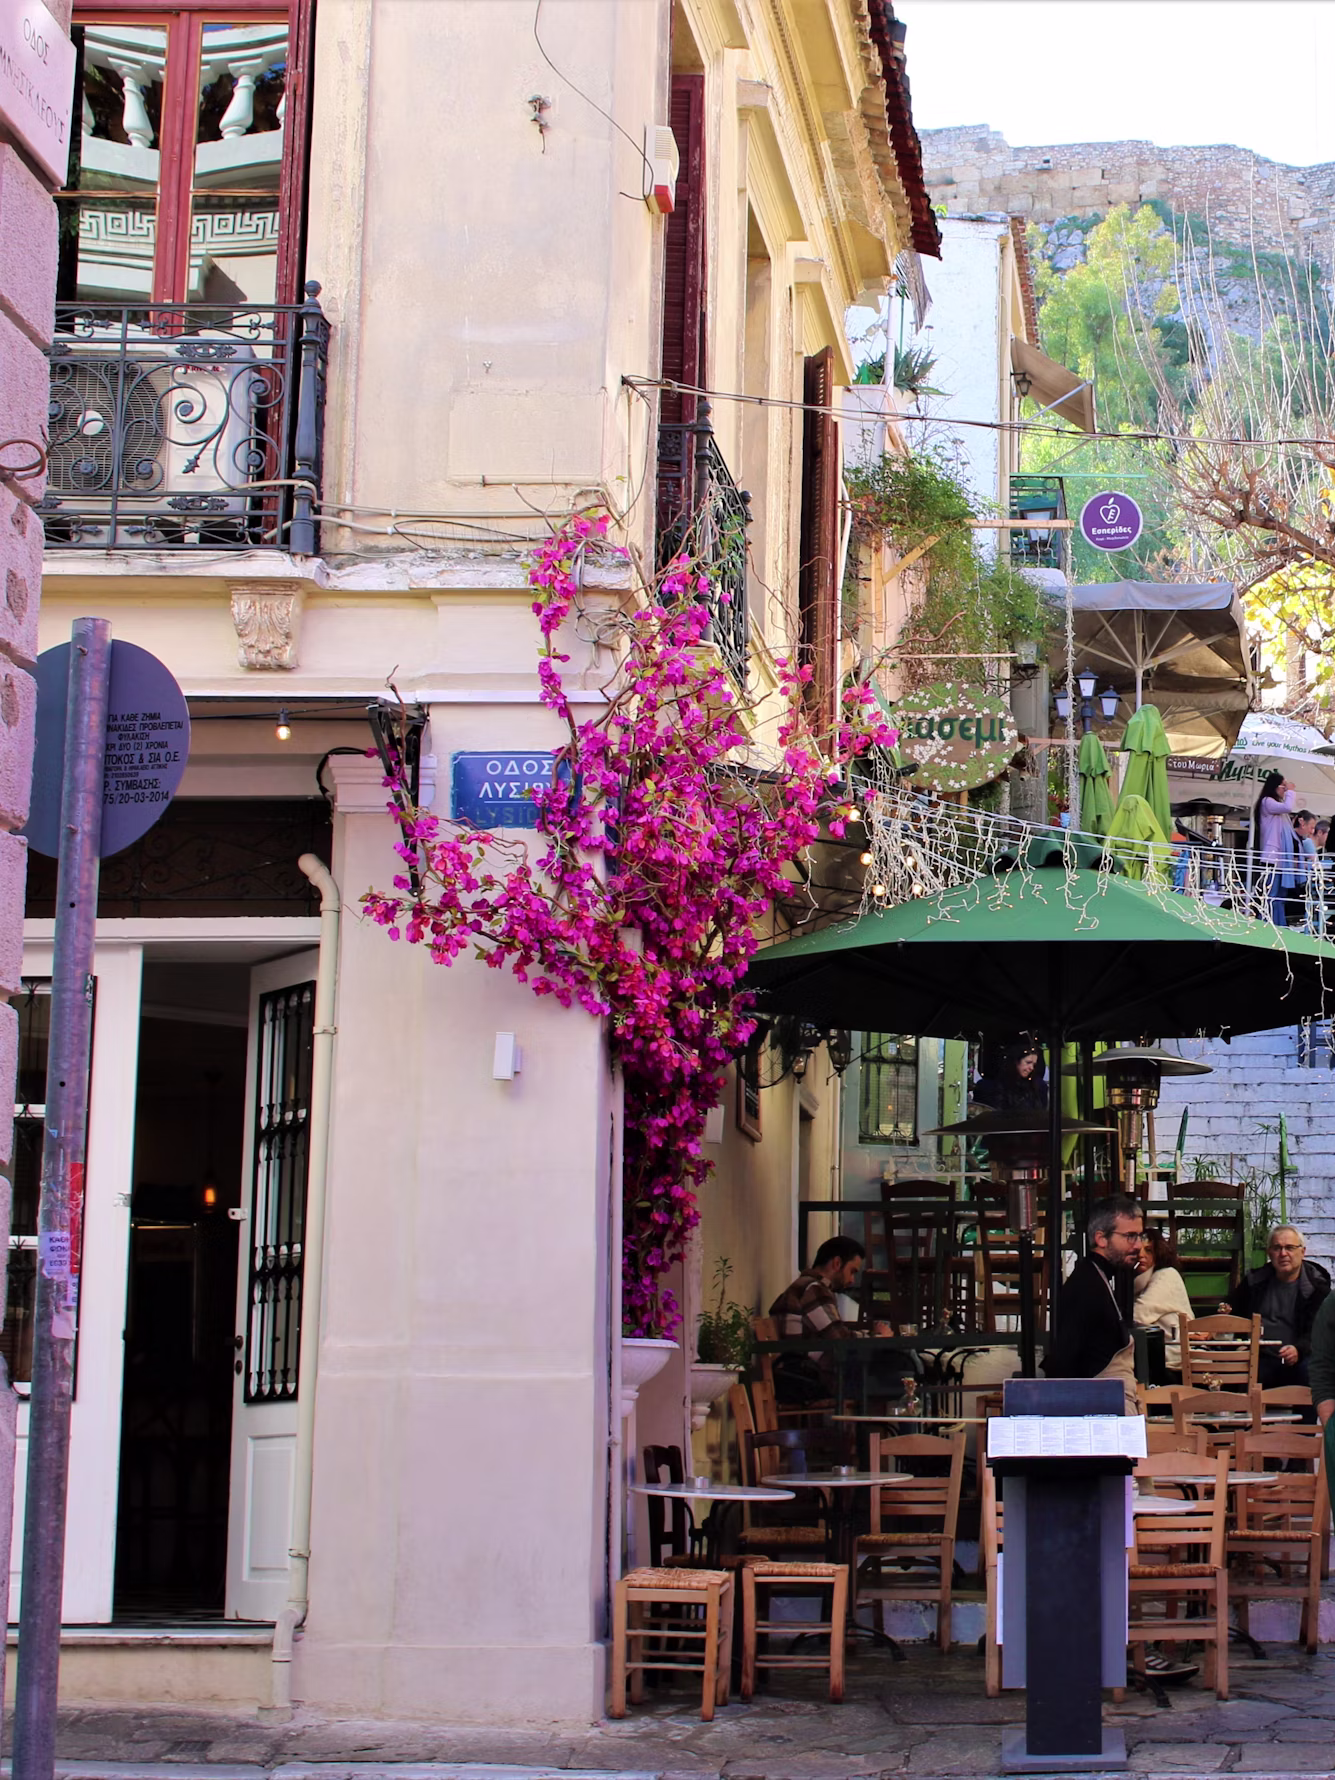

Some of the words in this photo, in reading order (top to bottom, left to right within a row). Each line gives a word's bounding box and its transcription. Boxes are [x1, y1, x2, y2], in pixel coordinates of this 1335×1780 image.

[23, 18, 49, 66] ΟΔΟΣ
[121, 713, 139, 722] ΚΑΘΕ
[106, 723, 137, 732] ΙΝΑΚΙΔΕΣ
[118, 742, 131, 751] ΔΥΟ
[133, 742, 143, 750] (2)
[145, 741, 168, 750] ΧΡΟΝΙΑ
[1283, 743, 1306, 753] Mythos
[148, 753, 161, 763] ΣΙΑ
[486, 760, 554, 775] ΟΔΟΣ
